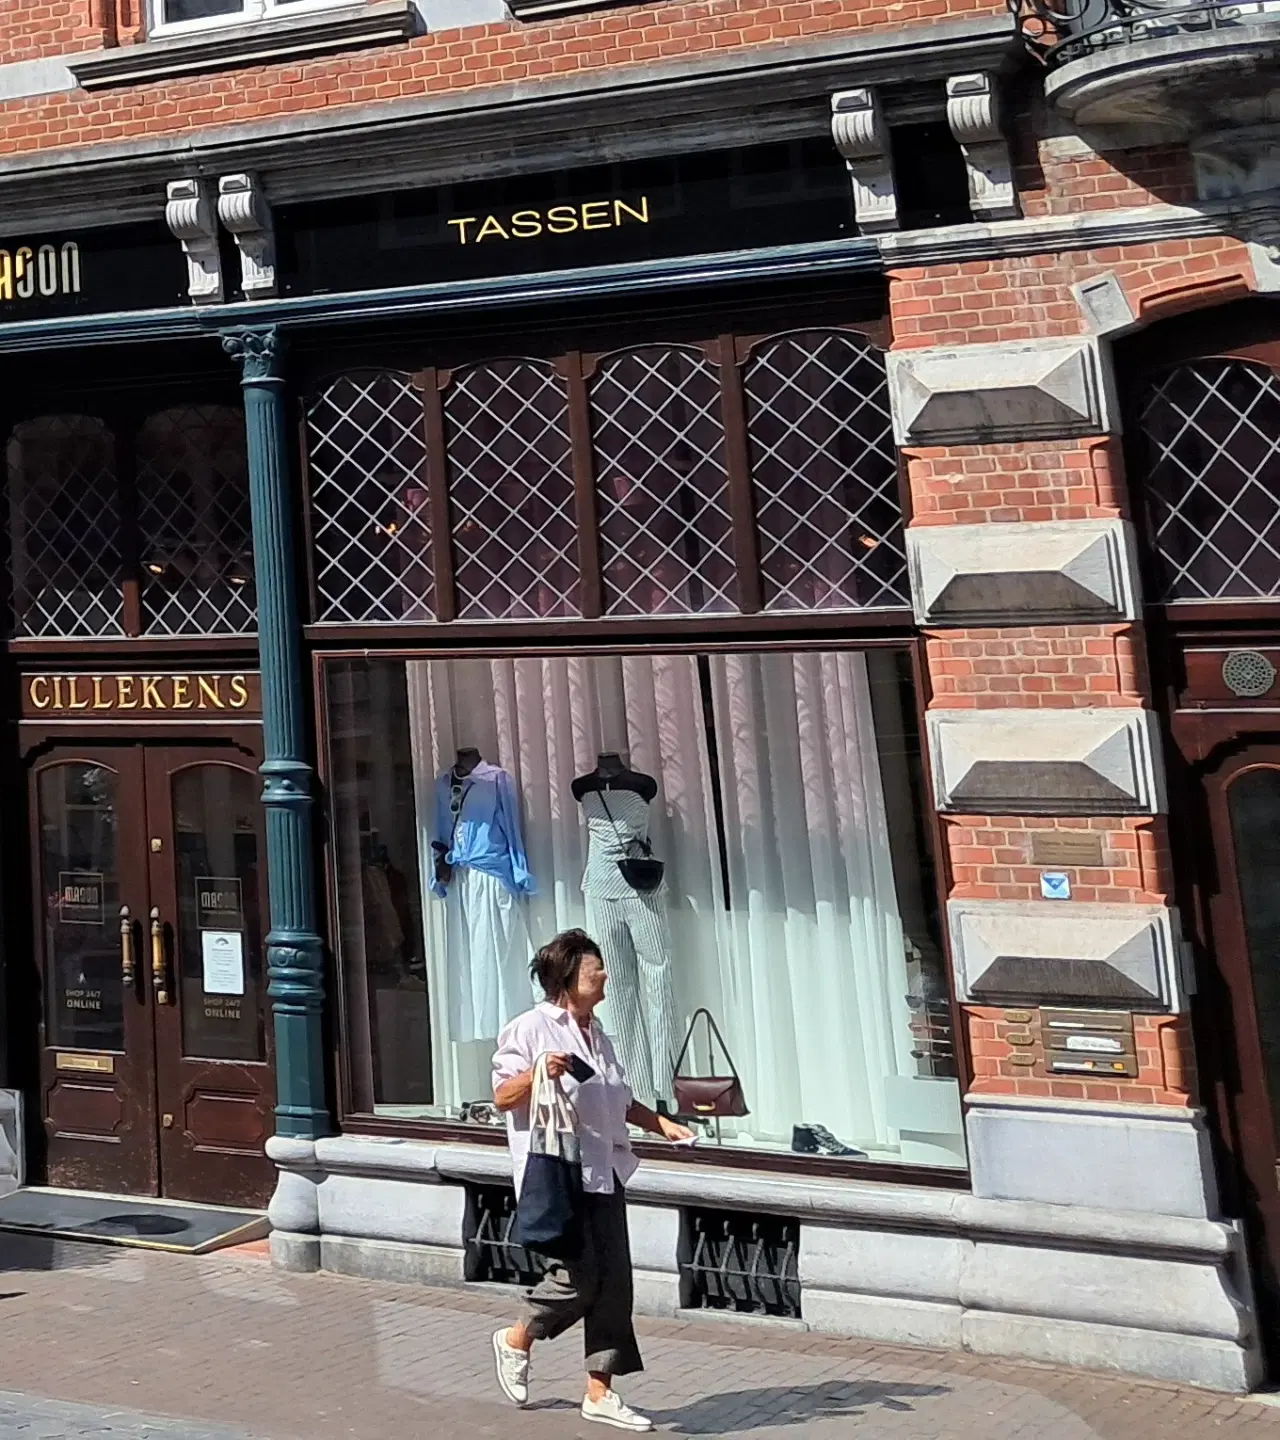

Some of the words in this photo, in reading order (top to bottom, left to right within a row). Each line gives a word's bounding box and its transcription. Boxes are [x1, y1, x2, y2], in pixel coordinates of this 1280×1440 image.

[447, 196, 649, 245] TASSEN
[29, 675, 249, 709] CILLEKENS
[64, 886, 99, 903] MASON
[66, 999, 101, 1010] ONLINE
[204, 1007, 241, 1019] ONLINE
